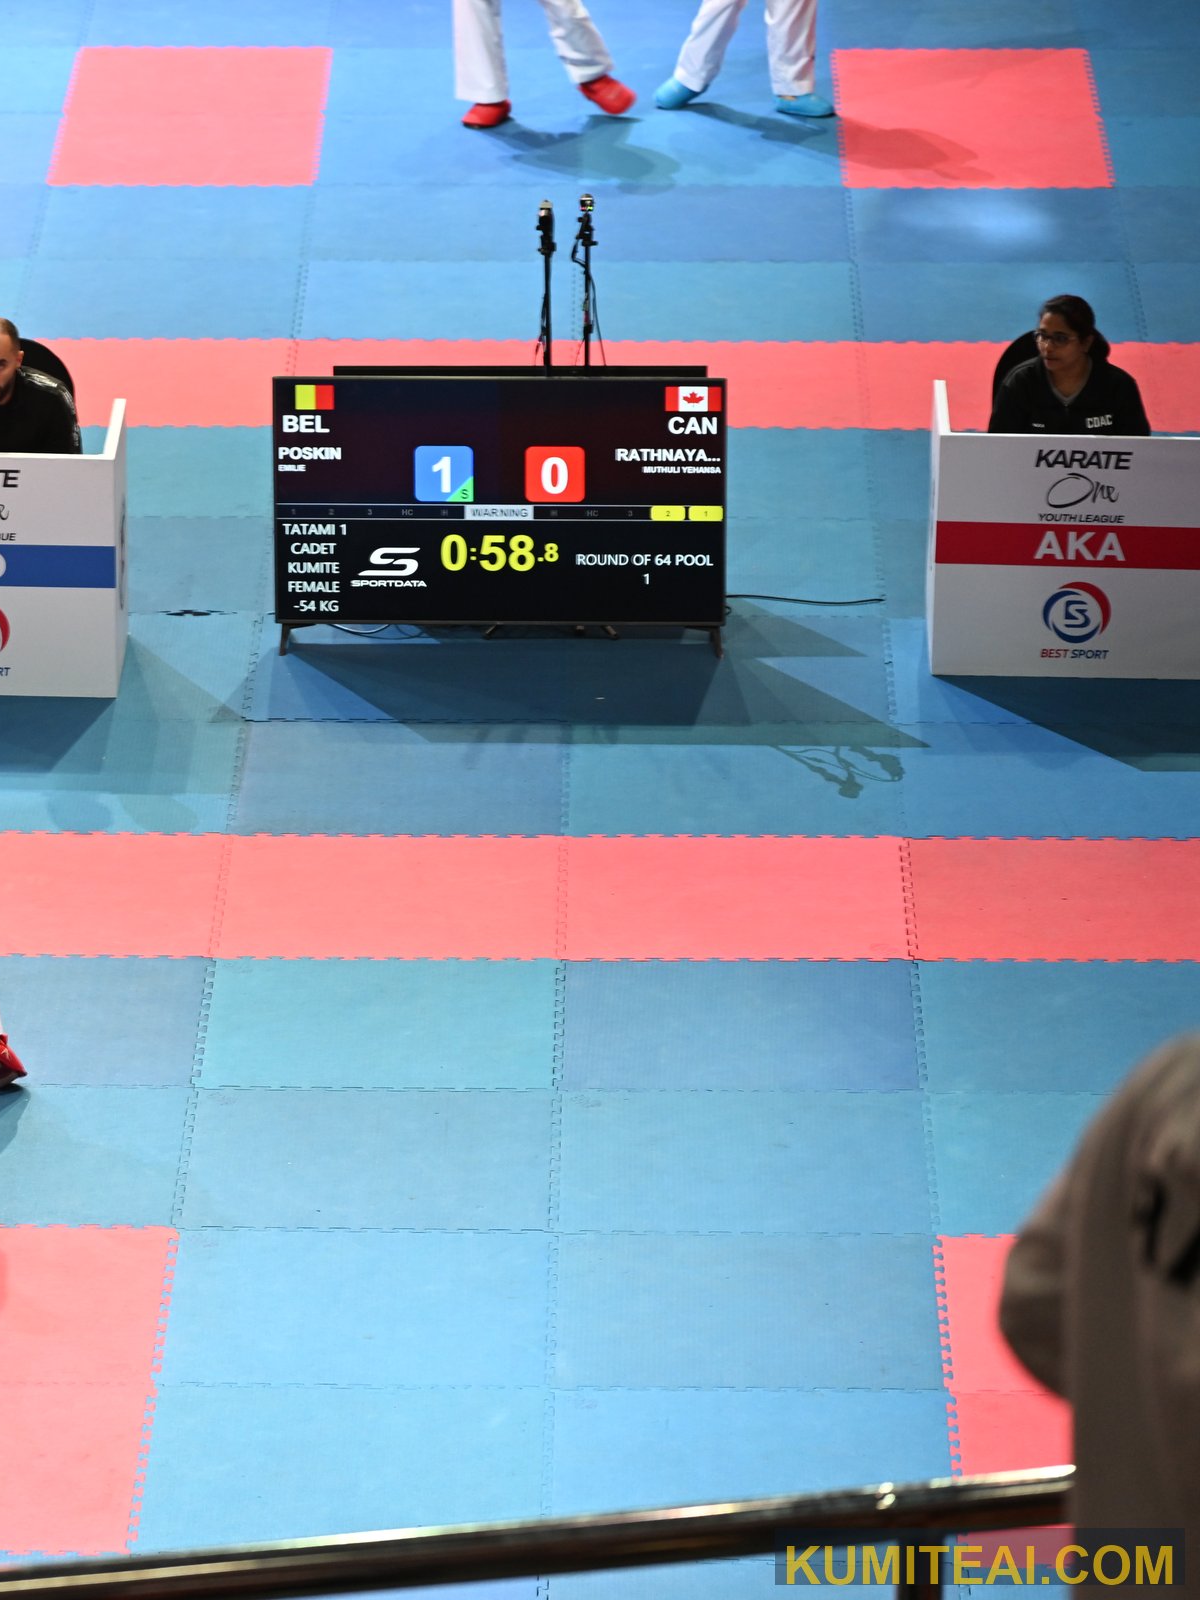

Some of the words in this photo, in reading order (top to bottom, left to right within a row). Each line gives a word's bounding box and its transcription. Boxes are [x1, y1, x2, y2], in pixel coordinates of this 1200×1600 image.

[282, 414, 330, 433] BEL
[667, 416, 718, 436] CAN
[278, 447, 342, 460] POSKIN
[615, 448, 721, 462] RATHNAYA...
[1035, 449, 1133, 470] KARATE
[431, 456, 452, 493] 1
[540, 456, 569, 494] 0
[643, 466, 680, 474] MUTHULI
[682, 466, 721, 474] YEHANSA
[460, 488, 469, 499] S
[1047, 473, 1120, 509] One
[367, 508, 373, 516] 3
[401, 508, 414, 516] HC
[471, 507, 529, 518] WARNING
[586, 509, 599, 517] HC
[627, 509, 634, 517] 3
[664, 509, 672, 517] 2
[1038, 513, 1077, 523] YOUTH
[1079, 514, 1125, 524] LEAGUE
[282, 523, 337, 536] TATAMI
[339, 523, 347, 535] 1
[290, 542, 337, 555] CADET
[1033, 530, 1126, 562] AKA
[576, 553, 629, 566] ROUND
[631, 553, 651, 566] OF
[654, 553, 672, 566] 64
[674, 554, 714, 566] POOL
[287, 562, 340, 574] KUMITE
[350, 579, 428, 588] SPORTDATA
[643, 573, 650, 585] 1
[287, 581, 341, 593] FEMALE
[294, 600, 317, 612] -54
[319, 600, 340, 612] KG
[1040, 648, 1069, 658] BEST
[1070, 649, 1109, 659] SPORT
